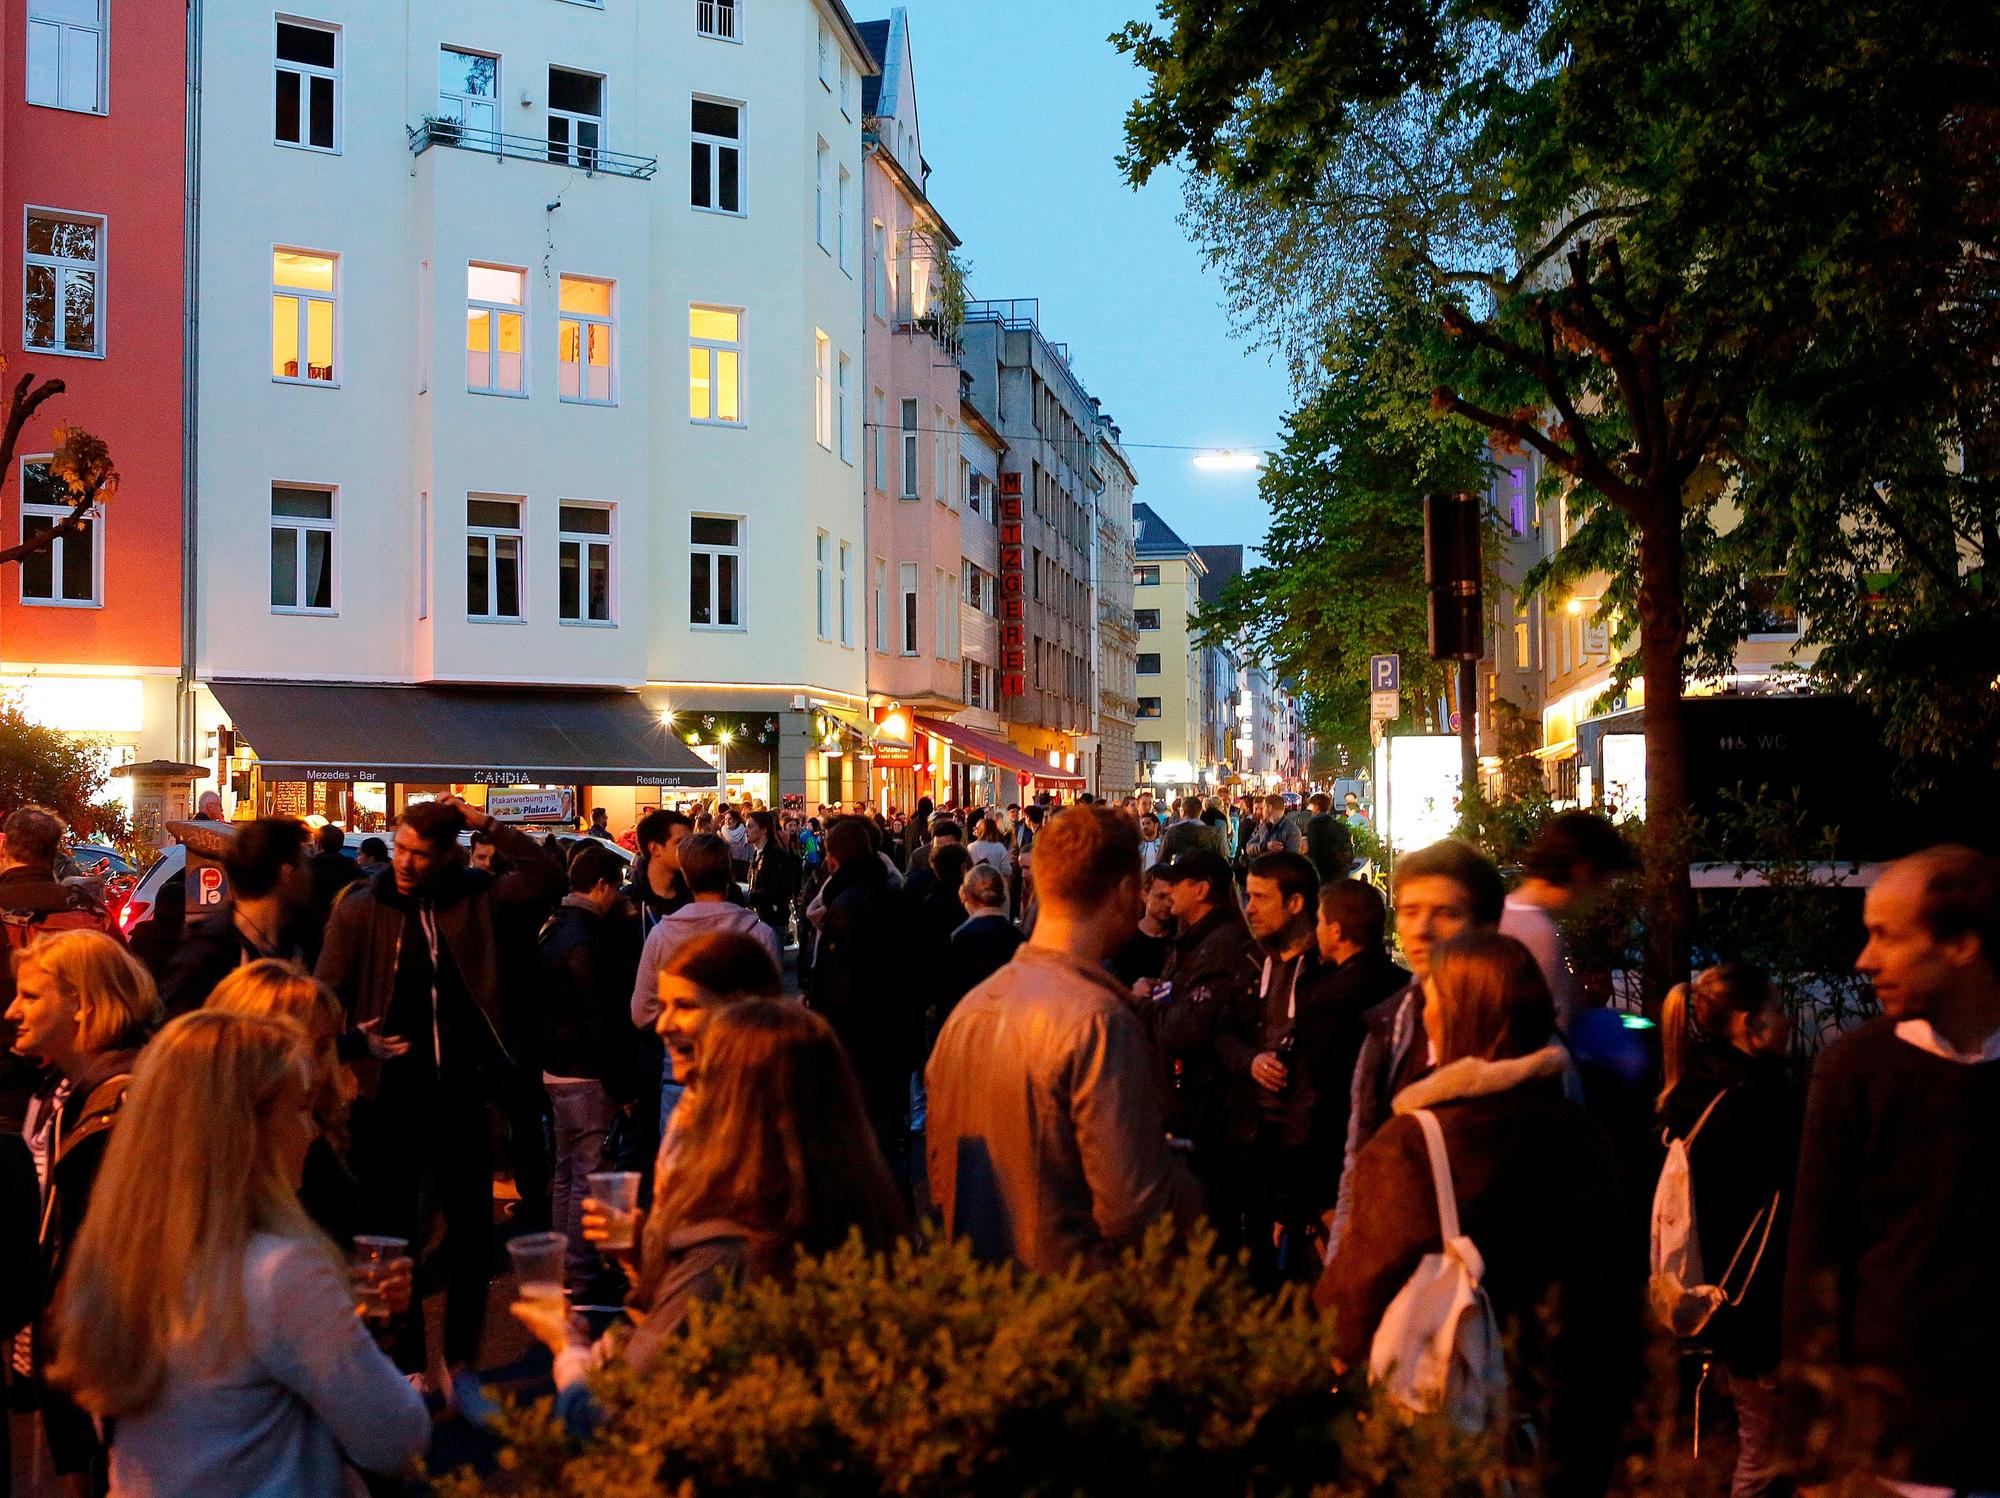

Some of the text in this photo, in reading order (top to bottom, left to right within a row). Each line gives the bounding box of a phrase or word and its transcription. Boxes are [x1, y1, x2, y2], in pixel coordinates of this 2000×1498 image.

[1002, 475, 1021, 694] METZGEREI
[1377, 660, 1393, 688] P
[1757, 734, 1787, 750] WC
[306, 770, 350, 780] Mezedes
[359, 770, 376, 781] Bar
[474, 771, 530, 784] CANDIA
[636, 776, 681, 785] Restaurant
[491, 793, 556, 805] Plakatwerbung mit
